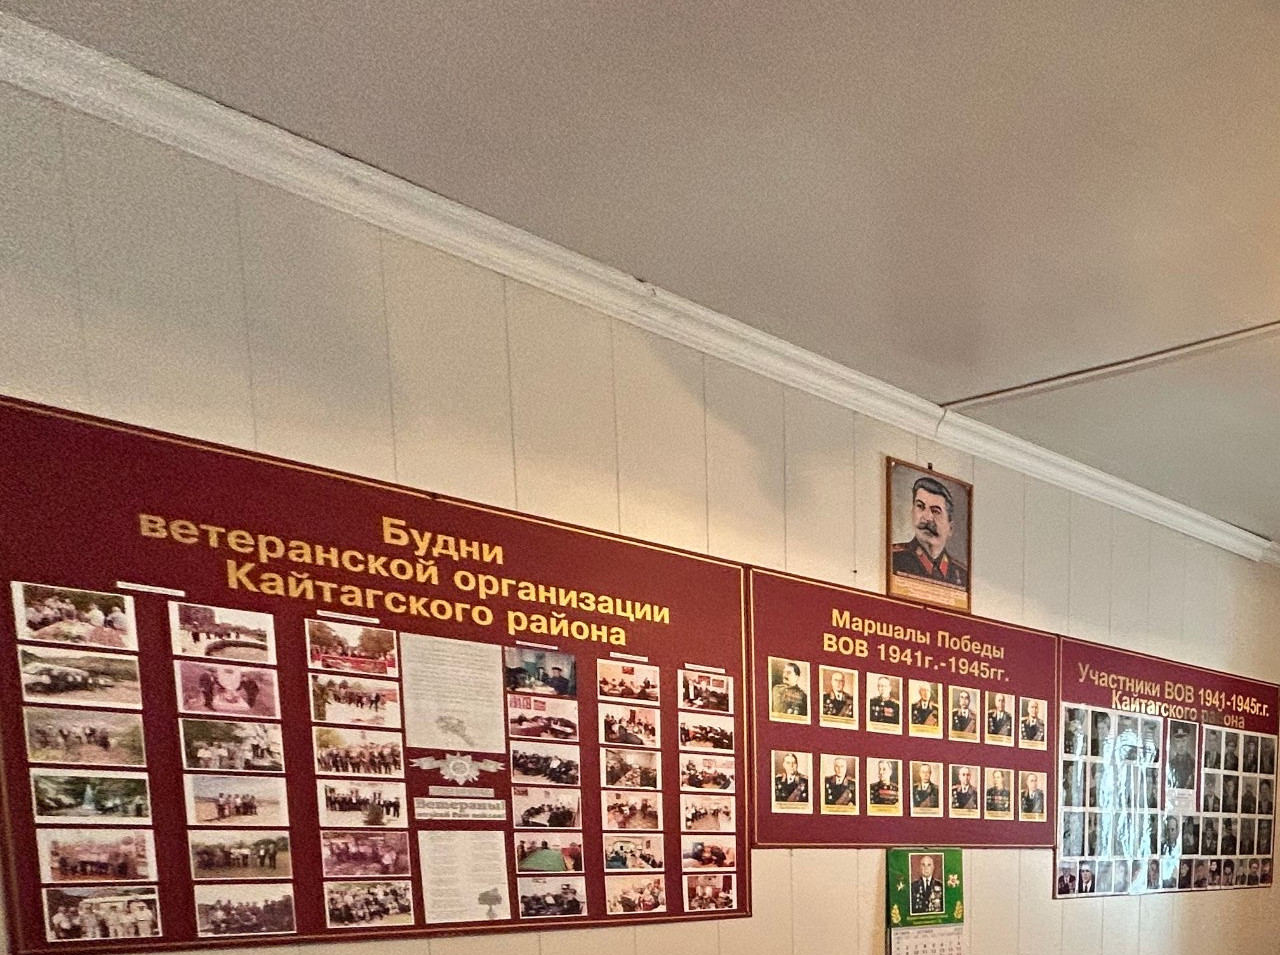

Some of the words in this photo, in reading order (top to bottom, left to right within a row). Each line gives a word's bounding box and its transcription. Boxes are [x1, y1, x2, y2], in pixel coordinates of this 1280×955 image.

[382, 516, 504, 564] Будни
[138, 513, 439, 585] ветеранской
[454, 570, 670, 624] организации
[227, 559, 494, 626] Кайтагского
[507, 610, 627, 646] района
[823, 633, 869, 658] ВОВ
[831, 609, 931, 645] Маршалы
[937, 630, 1005, 659] Победы
[1078, 662, 1160, 697] Участники
[1164, 680, 1194, 703] ВОВ
[1199, 688, 1270, 717] 1941-1945г.г.
[1111, 690, 1197, 721] Кайтагского
[1201, 707, 1245, 729] раона
